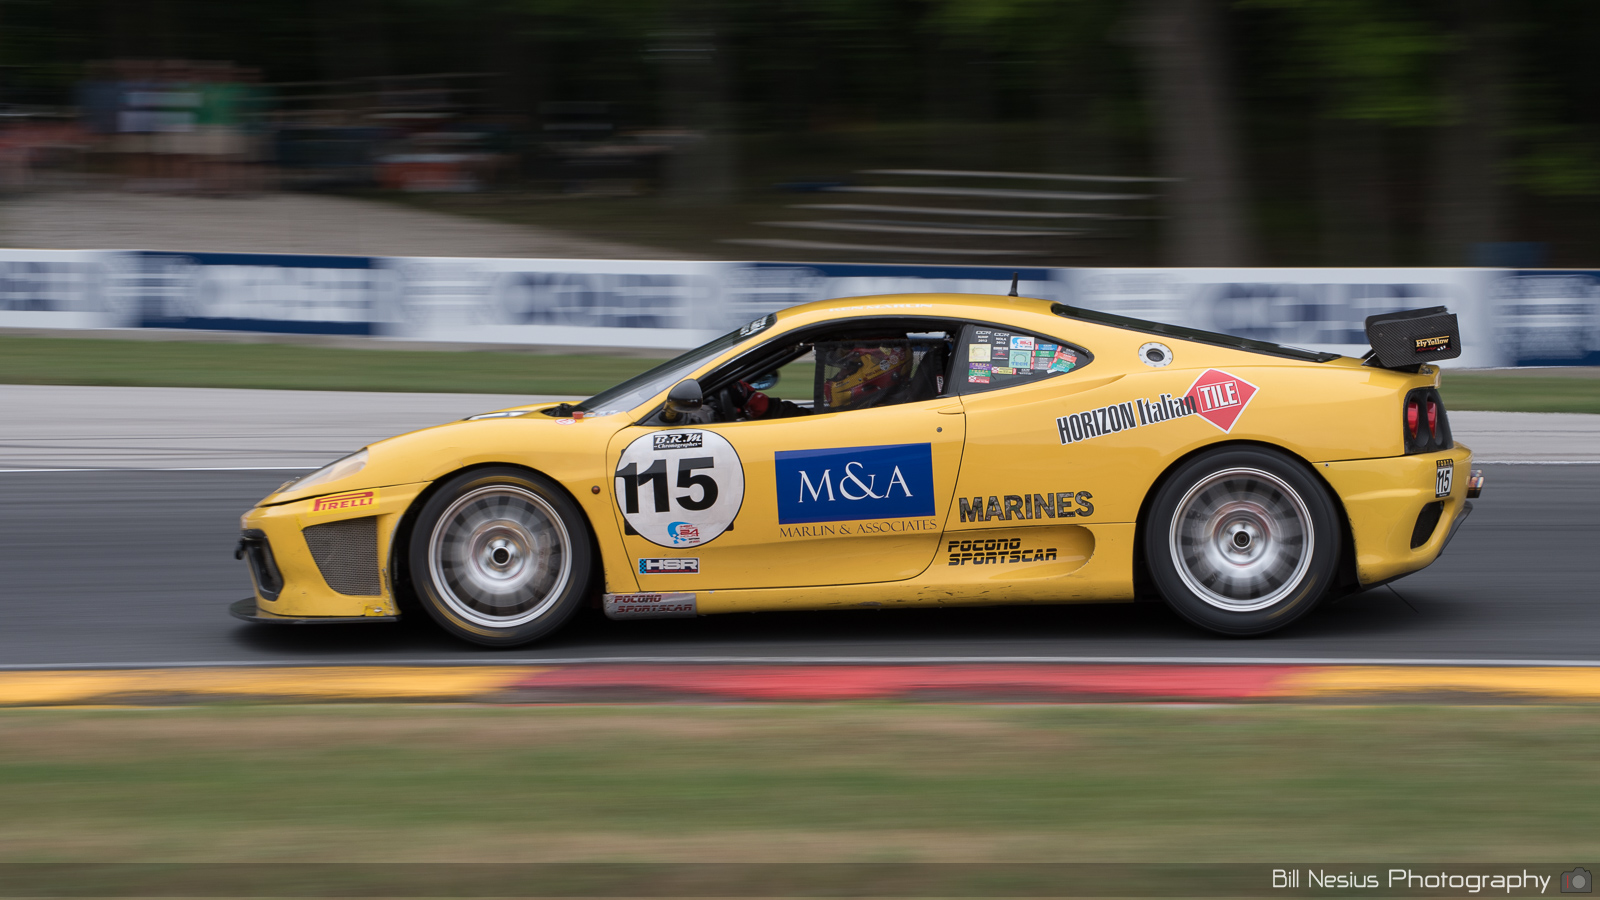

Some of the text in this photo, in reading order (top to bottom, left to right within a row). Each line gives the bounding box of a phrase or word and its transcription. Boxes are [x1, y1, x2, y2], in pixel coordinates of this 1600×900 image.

[1200, 381, 1239, 410] TILE
[1057, 394, 1197, 444] HORIZON Italian
[616, 456, 719, 514] 115
[798, 461, 913, 503] M&A
[1437, 469, 1451, 493] 115
[313, 491, 373, 512] PIRELLI
[959, 491, 1095, 522] MARINES
[779, 519, 938, 538] MARLIN & ASSOCIATES
[947, 538, 1021, 552] POCONO
[646, 559, 698, 570] HSR
[948, 548, 1057, 566] SPORTSCAR
[614, 594, 662, 604] POCONO
[616, 604, 693, 613] SPORTSCAR
